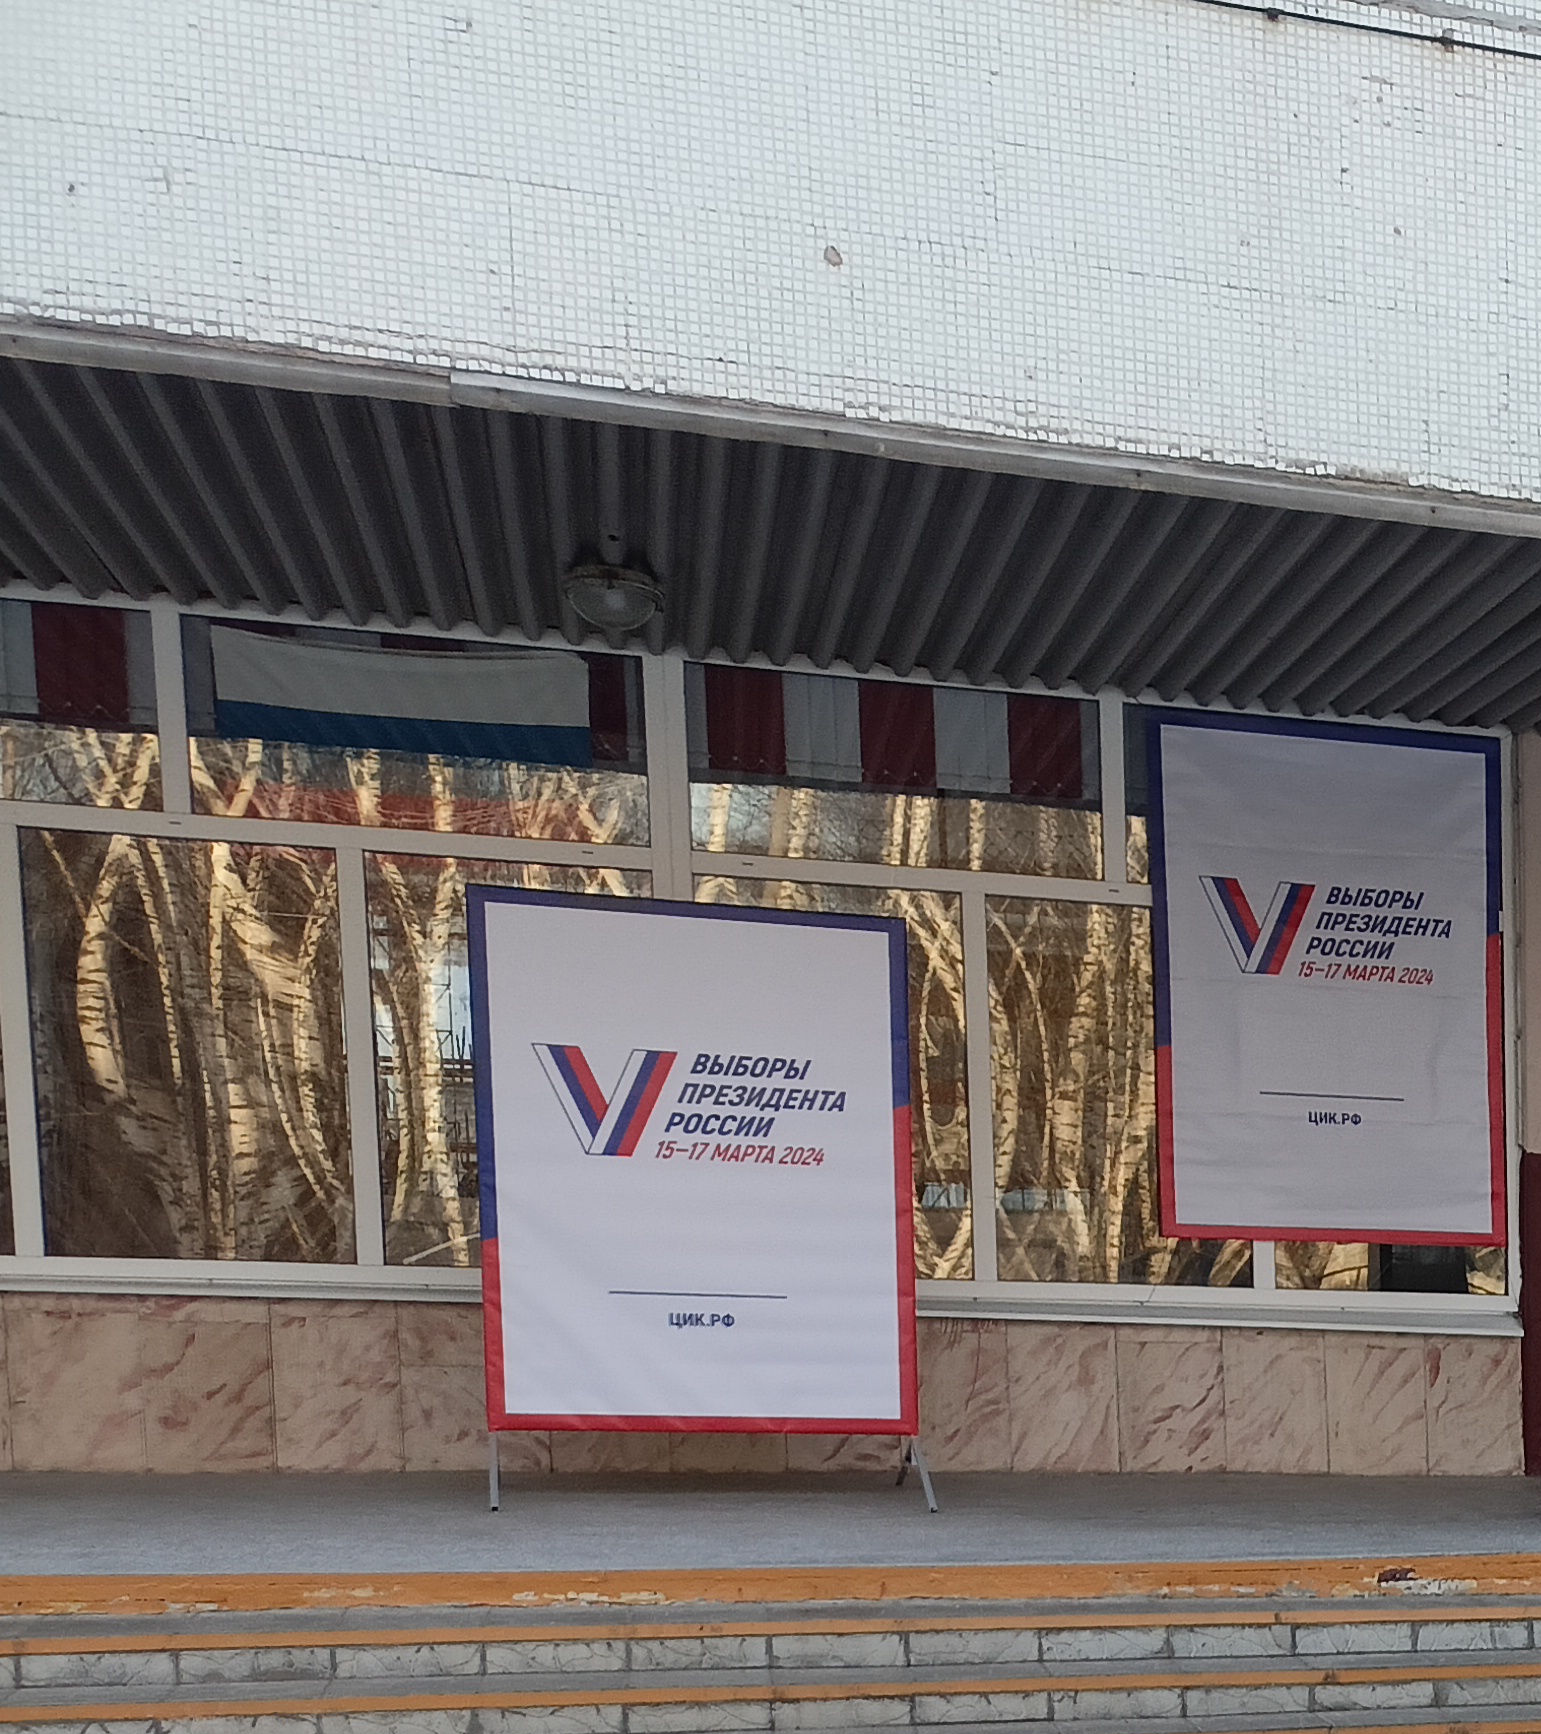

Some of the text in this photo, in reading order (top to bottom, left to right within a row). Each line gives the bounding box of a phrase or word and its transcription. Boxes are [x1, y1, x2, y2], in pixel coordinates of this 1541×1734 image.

[1325, 886, 1425, 911] ВЫБОРЫ
[1315, 911, 1453, 939] ПРЕЗИДЕНТА
[1305, 936, 1396, 960] РОССИИ
[1342, 963, 1396, 983] МАРТА
[1397, 967, 1434, 985] 2024
[689, 1053, 812, 1081] ВЫБОРЫ
[677, 1082, 847, 1113] ПРЕЗИДЕНТА
[664, 1112, 776, 1138] РОССИИ
[1308, 1110, 1362, 1126] ЦИК.РФ
[710, 1143, 776, 1164] МАРТА
[778, 1146, 825, 1167] 2024
[669, 1312, 735, 1329] ЦИК.РФ
